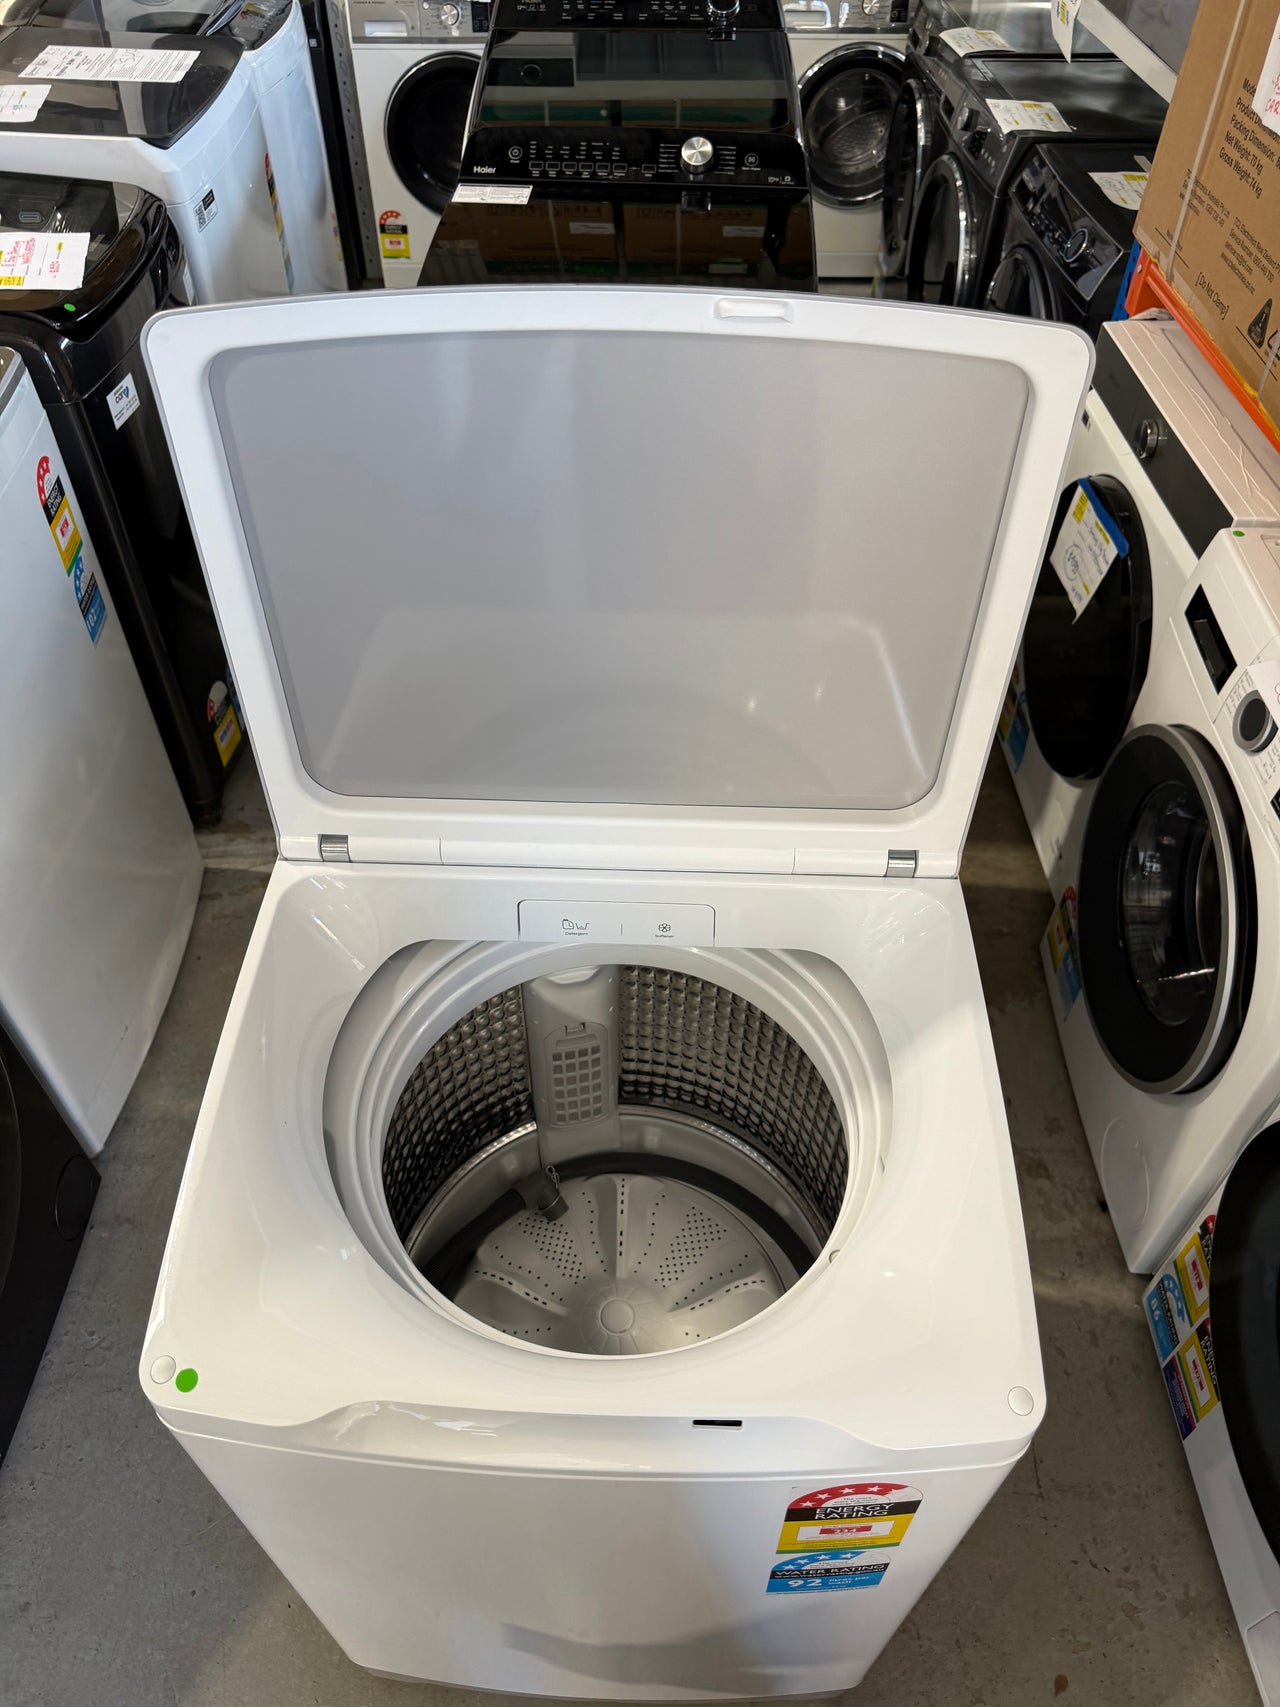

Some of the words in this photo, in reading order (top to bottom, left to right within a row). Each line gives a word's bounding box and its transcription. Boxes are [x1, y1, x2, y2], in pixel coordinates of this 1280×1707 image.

[1242, 78, 1257, 98] Mode
[1235, 96, 1255, 122] Product
[1230, 114, 1249, 141] Packing
[1225, 130, 1235, 146] Net
[1256, 160, 1263, 176] kg
[474, 166, 496, 174] Haier
[1219, 147, 1232, 168] Gross
[1256, 183, 1263, 199] kg
[47, 482, 60, 509] ENERGY
[50, 491, 63, 518] RATING
[815, 1510, 889, 1520] RATING
[816, 1503, 895, 1514] ENERGY
[830, 1564, 885, 1573] RATING
[787, 1578, 822, 1588] 92
